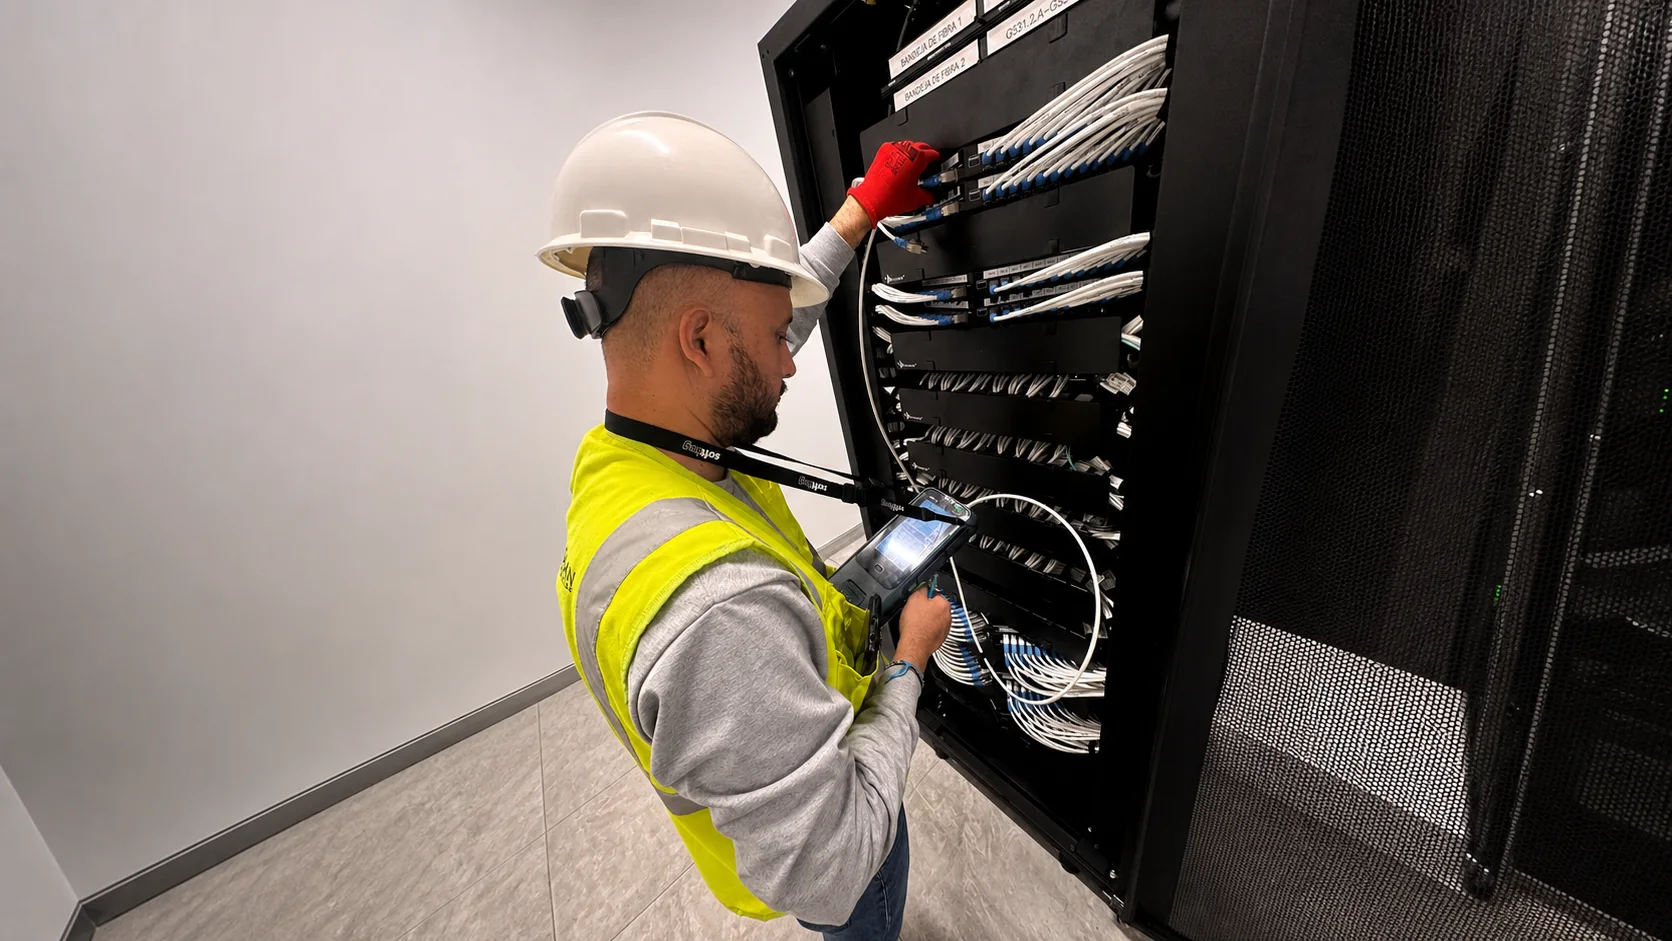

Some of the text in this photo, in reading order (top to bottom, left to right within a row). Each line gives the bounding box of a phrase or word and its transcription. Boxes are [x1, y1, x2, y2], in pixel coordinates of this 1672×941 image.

[900, 42, 928, 68] BANDEJA
[927, 34, 938, 48] DE
[937, 21, 957, 42] FIBRA
[904, 79, 932, 102] BANDEJA
[940, 62, 960, 79] FIBRA
